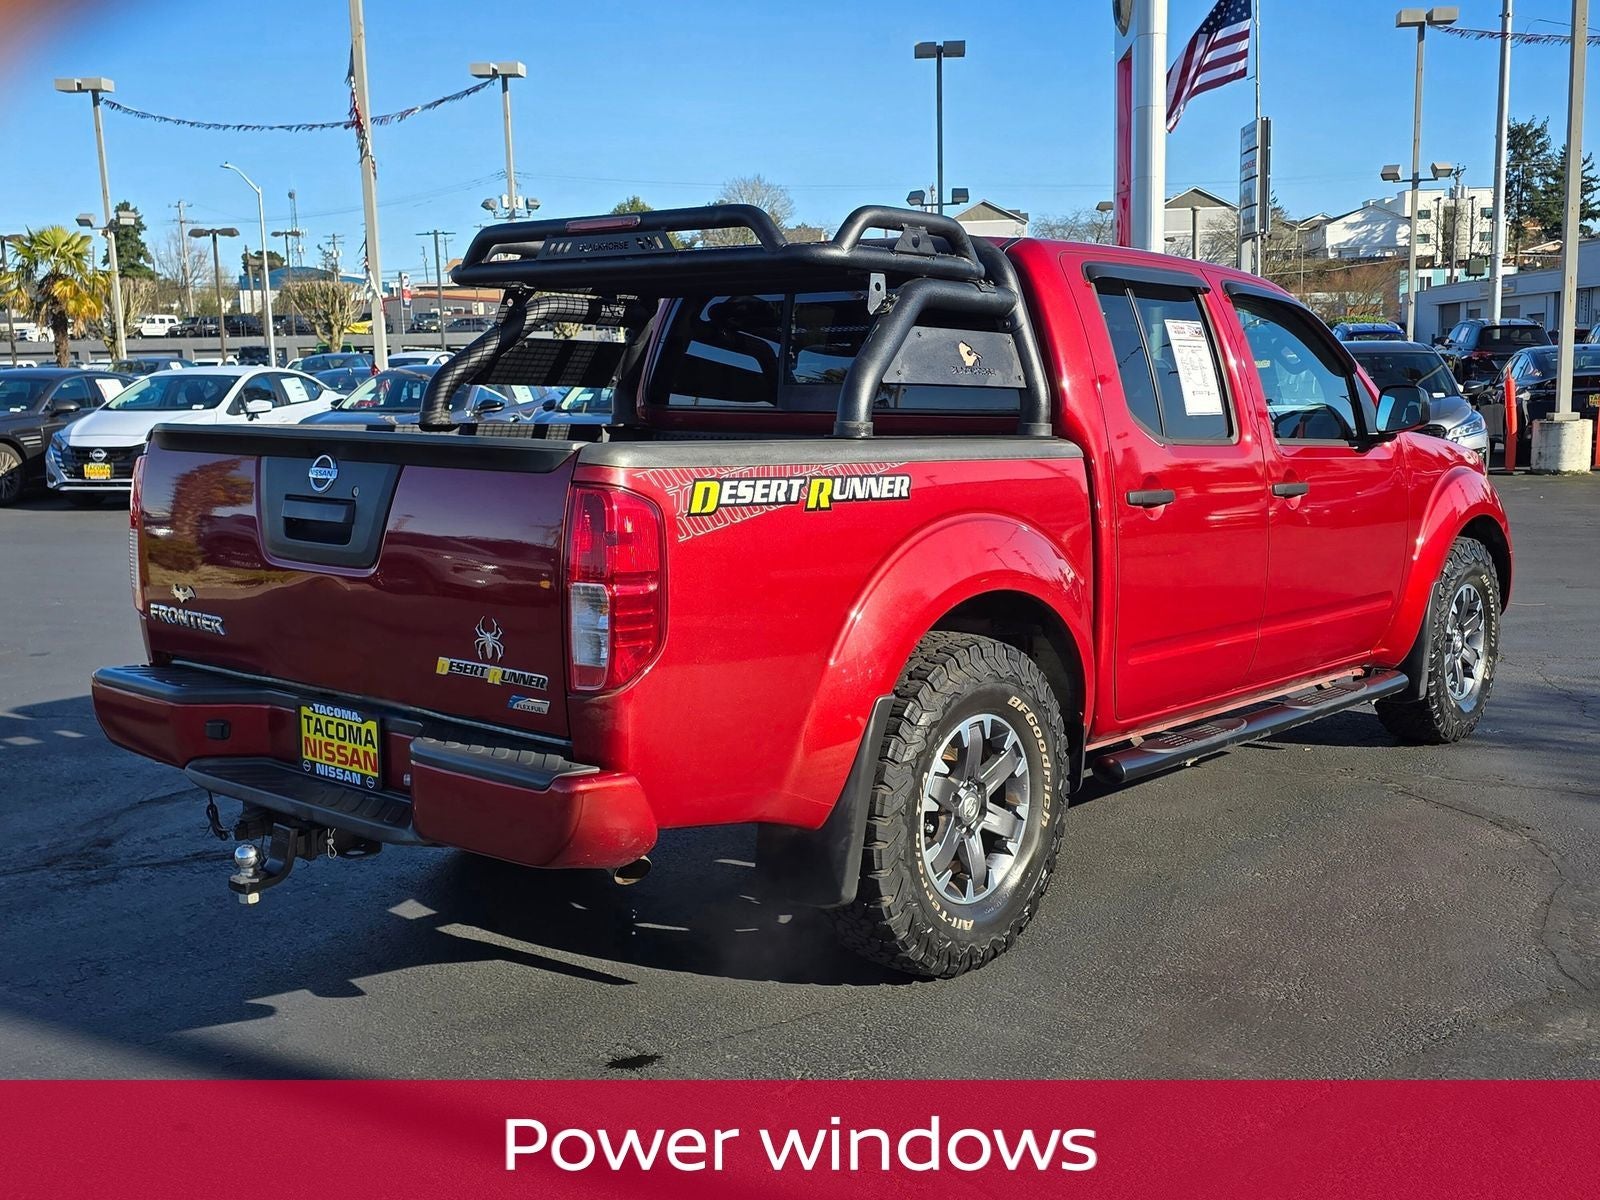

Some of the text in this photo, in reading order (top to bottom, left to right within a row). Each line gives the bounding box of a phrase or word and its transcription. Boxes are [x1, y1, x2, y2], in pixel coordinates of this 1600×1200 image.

[689, 475, 911, 516] DESERT RUNNER
[150, 603, 225, 635] FRONTIER
[436, 657, 548, 691] DESERT RUNNER
[312, 703, 360, 722] TACOMA
[303, 714, 377, 749] TACOMA
[303, 736, 378, 773] NISSAN
[315, 762, 361, 785] NISSAN
